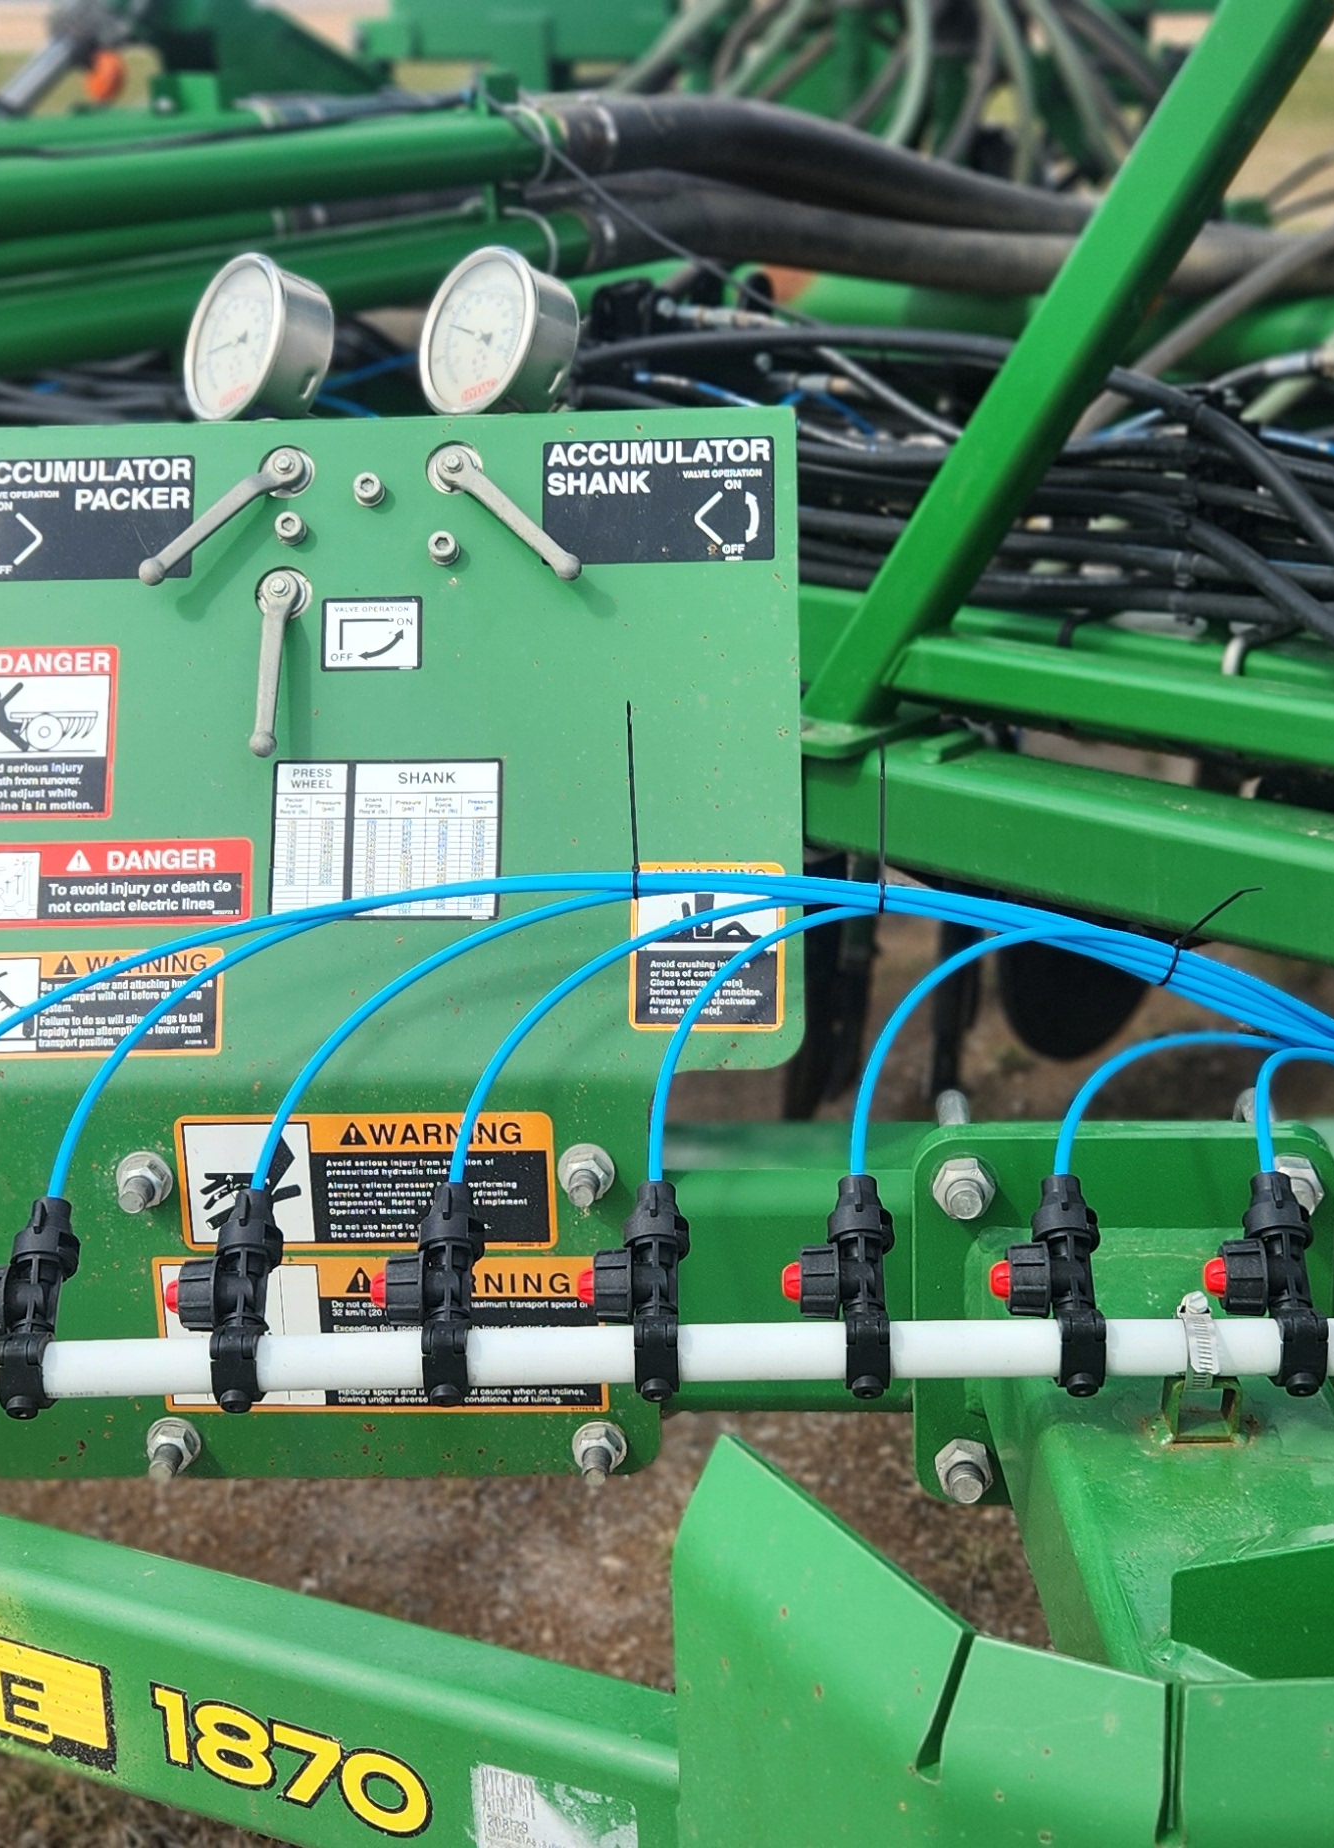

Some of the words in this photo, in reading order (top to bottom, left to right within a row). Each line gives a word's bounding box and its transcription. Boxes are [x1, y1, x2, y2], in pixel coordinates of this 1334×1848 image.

[547, 439, 770, 466] ACCUMULATOR
[683, 470, 710, 479] VALVE
[711, 468, 762, 478] OPERATION
[547, 470, 650, 496] SHANK
[724, 479, 741, 490] ON
[10, 490, 59, 499] OPERATION
[75, 487, 191, 511] PACKER
[722, 544, 745, 554] OFF
[330, 653, 353, 661] OFF
[7, 763, 49, 772] serious
[51, 763, 84, 773] injury
[292, 769, 332, 778] PRESS
[398, 772, 456, 784] SHANK
[15, 776, 38, 785] from
[40, 776, 81, 785] runover.
[291, 780, 333, 789] WHEEL
[10, 789, 45, 799] adjust
[48, 788, 78, 798] while
[22, 802, 32, 811] is
[35, 802, 46, 810] in
[50, 801, 93, 810] motion.
[107, 849, 215, 871] DANGER
[49, 883, 66, 895] To
[70, 882, 108, 896] avoid
[112, 882, 150, 898] injury
[153, 883, 169, 894] or
[171, 880, 210, 893] death
[213, 879, 231, 892] do
[48, 901, 72, 914] not
[74, 900, 125, 913] contact
[128, 898, 178, 912] electric
[182, 898, 214, 910] lines
[650, 960, 675, 968] Avoid
[677, 960, 715, 969] crushing
[662, 969, 680, 977] loss
[682, 969, 692, 977] of
[111, 980, 128, 989] and
[130, 979, 169, 990] attaching
[650, 979, 675, 987] Close
[97, 992, 116, 1000] with
[118, 991, 129, 1000] oil
[132, 991, 159, 1000] before
[650, 988, 678, 996] before
[722, 988, 763, 996] machine.
[650, 997, 681, 1006] Always
[711, 997, 756, 1005] clockwise
[649, 1006, 658, 1014] to
[661, 1006, 684, 1014] close
[40, 1016, 70, 1026] Failure
[72, 1017, 81, 1025] to
[82, 1015, 94, 1024] do
[108, 1014, 124, 1024] will
[179, 1014, 187, 1022] to
[189, 1012, 203, 1022] fall
[39, 1027, 69, 1038] rapidly
[70, 1025, 94, 1036] when
[155, 1025, 179, 1034] lower
[181, 1024, 201, 1033] from
[39, 1038, 77, 1049] transport
[79, 1036, 117, 1048] position.
[390, 1159, 416, 1168] injury
[326, 1168, 379, 1177] pressurized
[382, 1168, 423, 1178] hydraulic
[328, 1182, 359, 1190] Always
[329, 1208, 376, 1216] Operator's
[331, 1300, 344, 1308] Do
[509, 1300, 548, 1309] transport
[551, 1301, 577, 1309] speed
[368, 1309, 382, 1317] (20
[552, 1387, 587, 1396] inclines,
[531, 1396, 563, 1404] turning.
[150, 1681, 433, 1838] 1870
